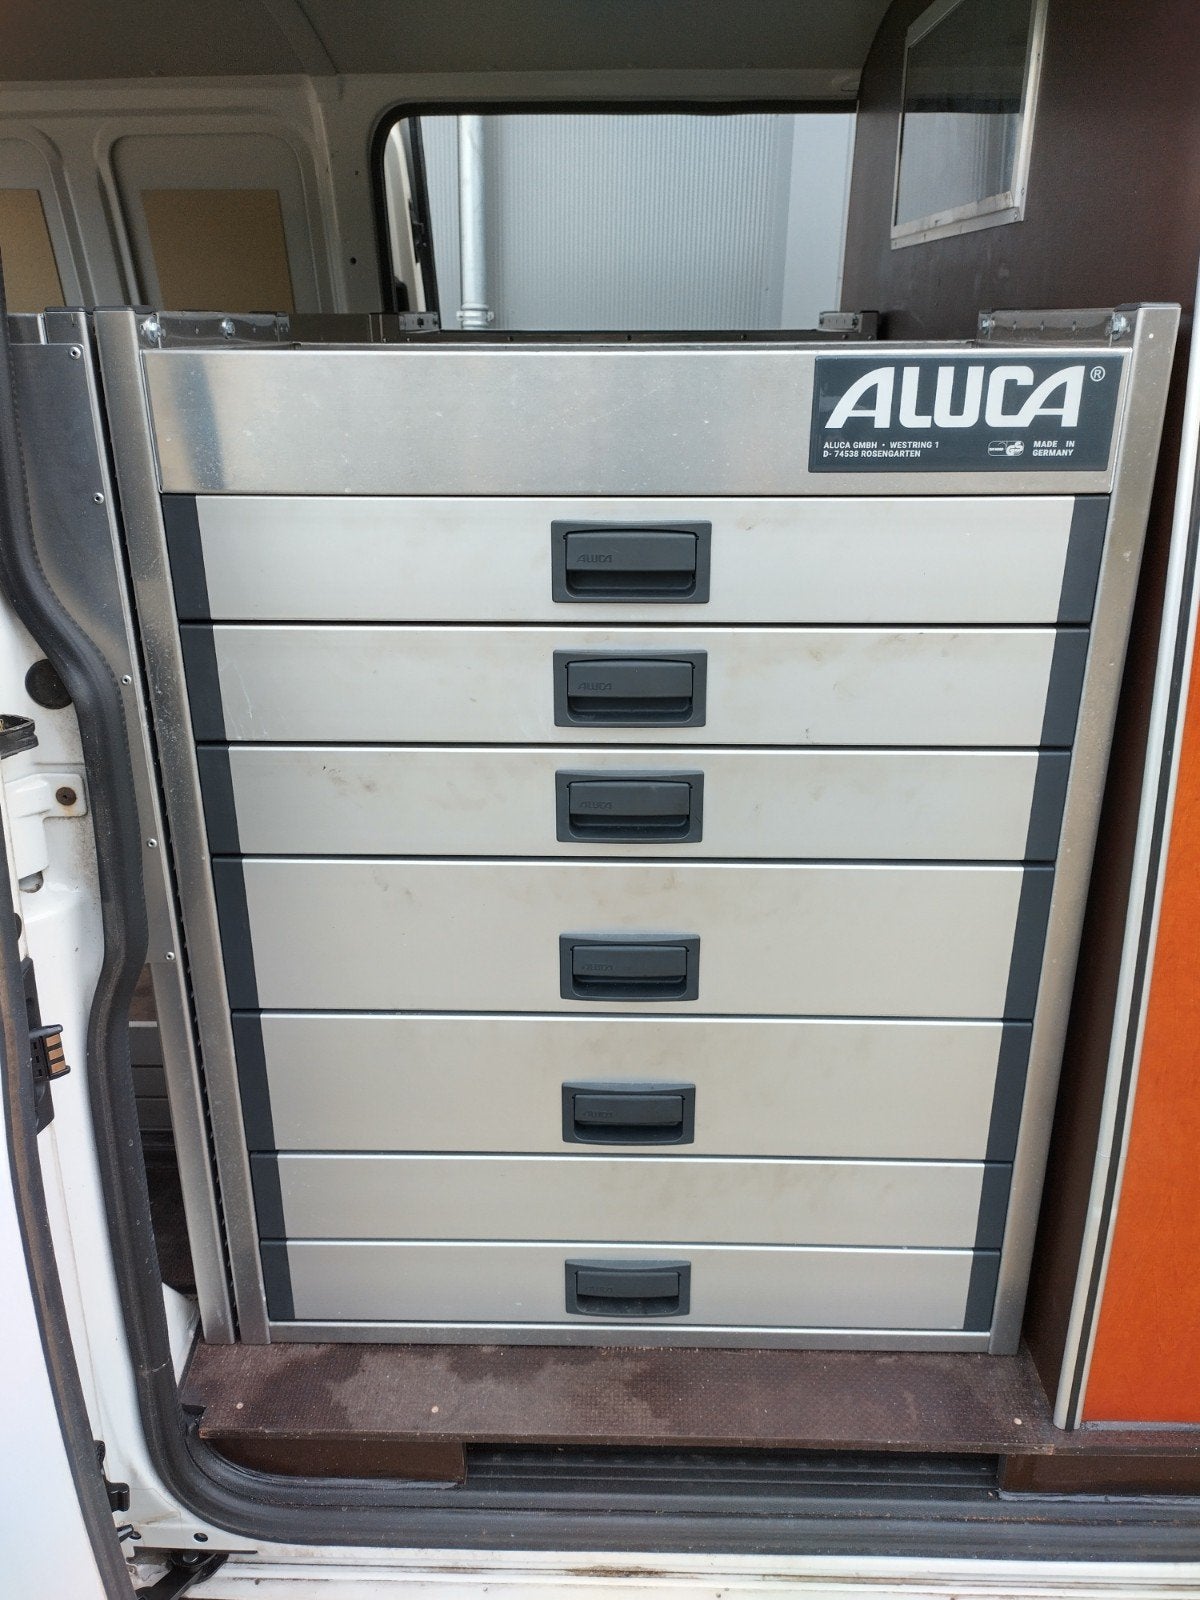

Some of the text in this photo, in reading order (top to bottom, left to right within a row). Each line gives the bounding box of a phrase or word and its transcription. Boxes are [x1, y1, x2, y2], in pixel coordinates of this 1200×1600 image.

[825, 365, 1086, 428] ALUCA
[823, 441, 851, 449] ALUCA
[852, 441, 878, 449] GMBH
[889, 441, 933, 449] WESTRING
[1033, 440, 1075, 448] MADE IN
[834, 450, 859, 458] 74538
[860, 450, 921, 458] ROSENGARTEN
[1032, 449, 1074, 457] GERMANY
